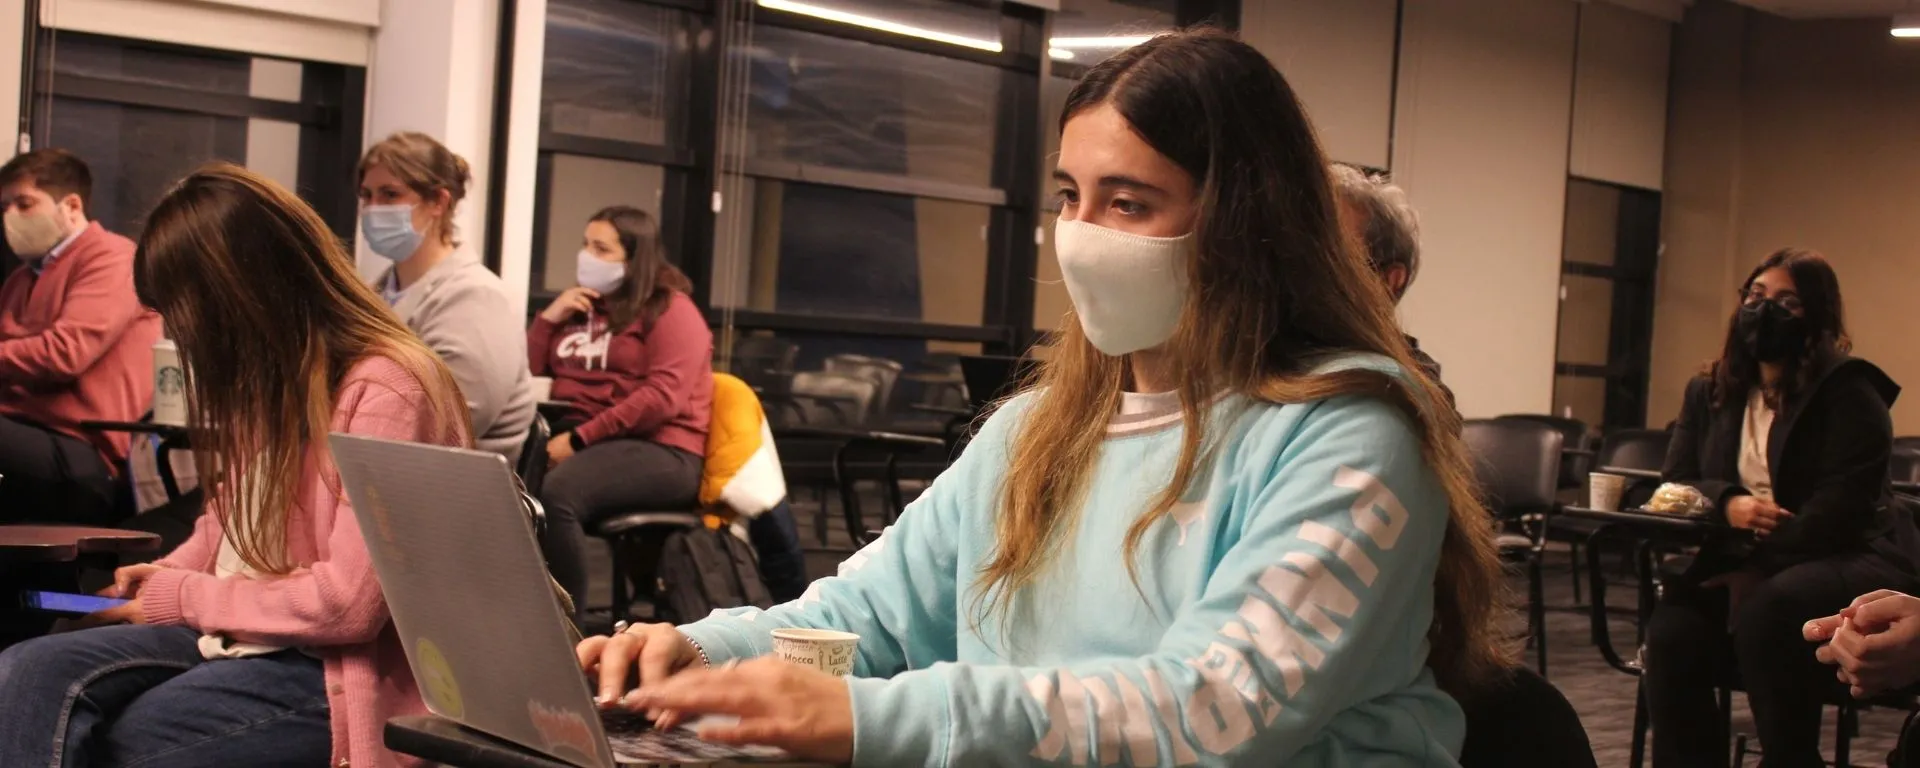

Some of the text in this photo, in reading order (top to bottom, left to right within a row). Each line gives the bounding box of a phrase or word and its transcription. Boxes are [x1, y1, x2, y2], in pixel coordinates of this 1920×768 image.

[1219, 465, 1410, 698] PINK
[784, 653, 814, 665] Mocca
[1028, 667, 1257, 767] PINK
